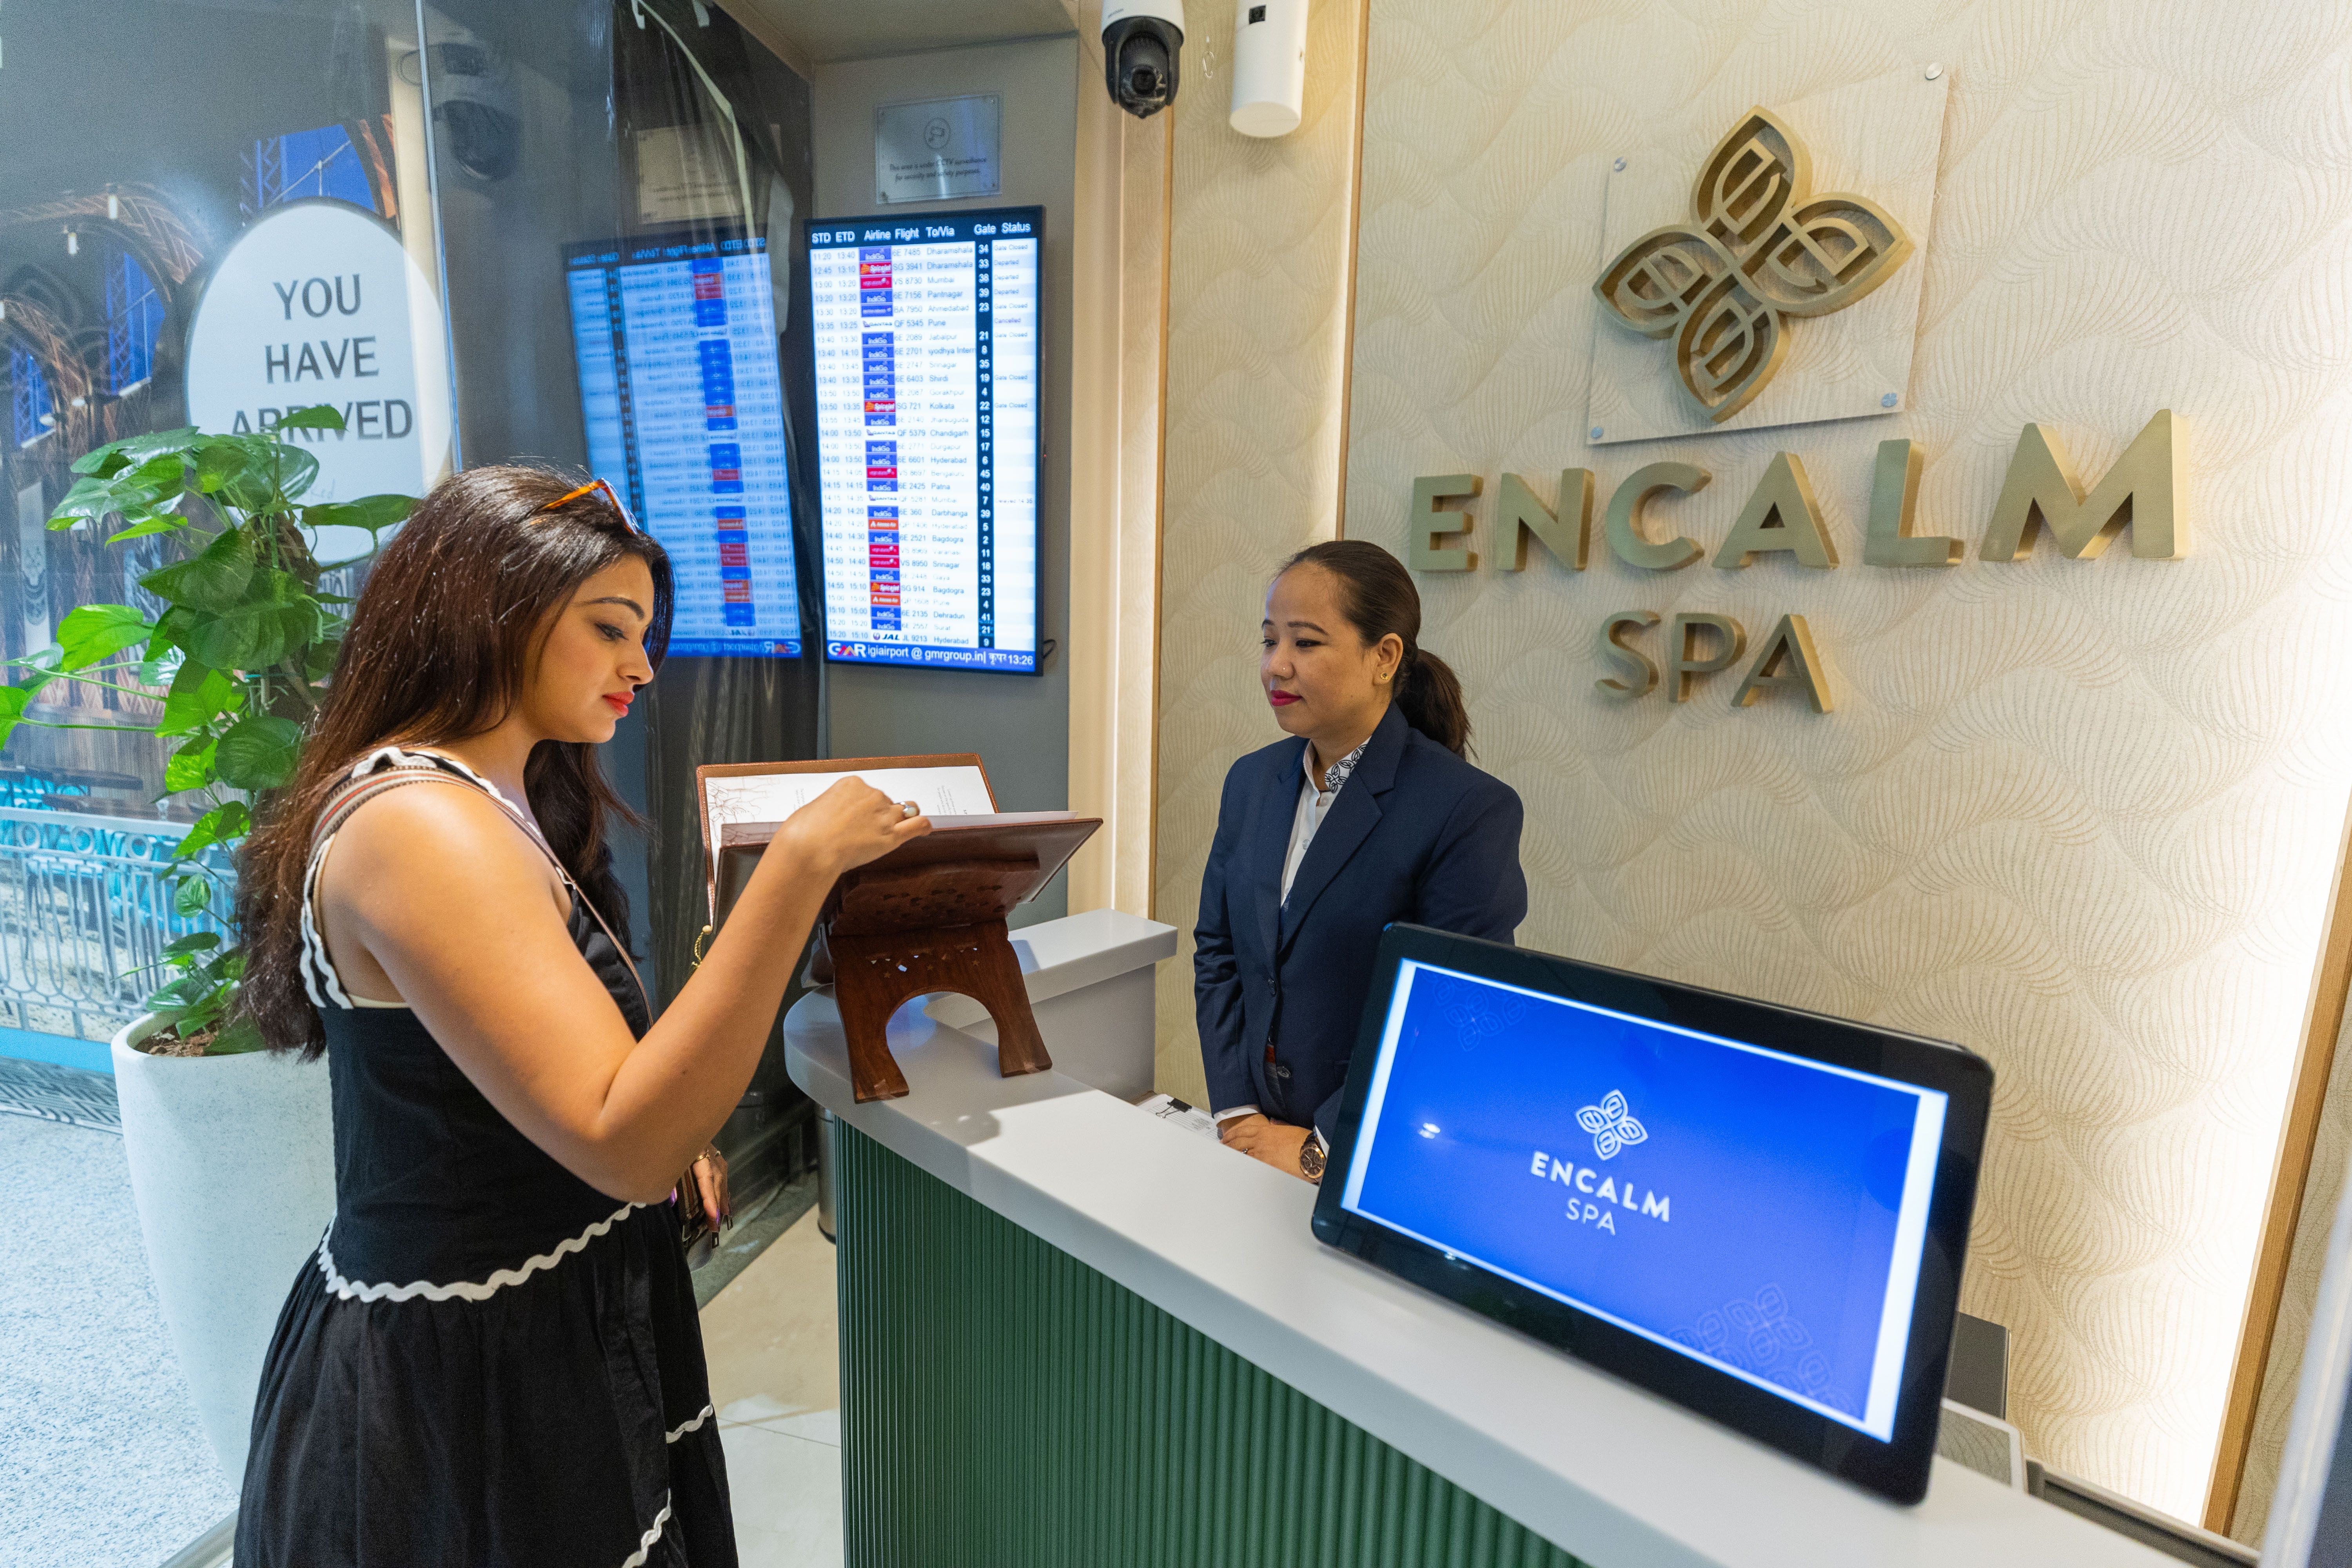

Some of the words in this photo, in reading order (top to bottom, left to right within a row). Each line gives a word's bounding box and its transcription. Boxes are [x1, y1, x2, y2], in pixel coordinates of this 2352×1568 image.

[811, 232, 831, 243] STD
[835, 231, 855, 242] ETD
[864, 229, 891, 241] Airline
[895, 227, 919, 241] Flight
[926, 225, 955, 238] To/Via
[974, 223, 996, 235] Gate
[1001, 221, 1031, 233] Status
[927, 245, 973, 255] Dharamshala
[979, 244, 989, 253] 34
[927, 260, 973, 270] Dharamshala
[979, 259, 989, 268] 33
[994, 259, 1019, 267] Departed
[927, 275, 955, 284] Mumbai
[979, 274, 989, 283] 38
[272, 274, 361, 320] YOU
[927, 290, 962, 300] Pantnagar
[979, 288, 989, 297] 39
[928, 304, 969, 312] Ahmedabad
[979, 303, 989, 311] 23
[265, 336, 379, 384] HAVE
[980, 374, 990, 382] 19
[980, 402, 990, 410] 22
[930, 430, 968, 438] Chandigarh
[981, 429, 990, 437] 15
[930, 457, 967, 465] Hyderabad
[1410, 409, 2191, 572] ENCALM
[931, 509, 968, 519] Darbhanga
[932, 535, 964, 544] Bagdogra
[933, 561, 959, 570] Srinagar
[933, 586, 964, 596] Bagdogra
[933, 636, 969, 646] Hyderabad
[867, 645, 908, 659] igiairport
[911, 648, 922, 660] @
[1008, 654, 1033, 665] 13:26
[1595, 609, 1834, 714] SPA
[1530, 1151, 1670, 1223] ENCALM
[1566, 1197, 1616, 1236] SPA
